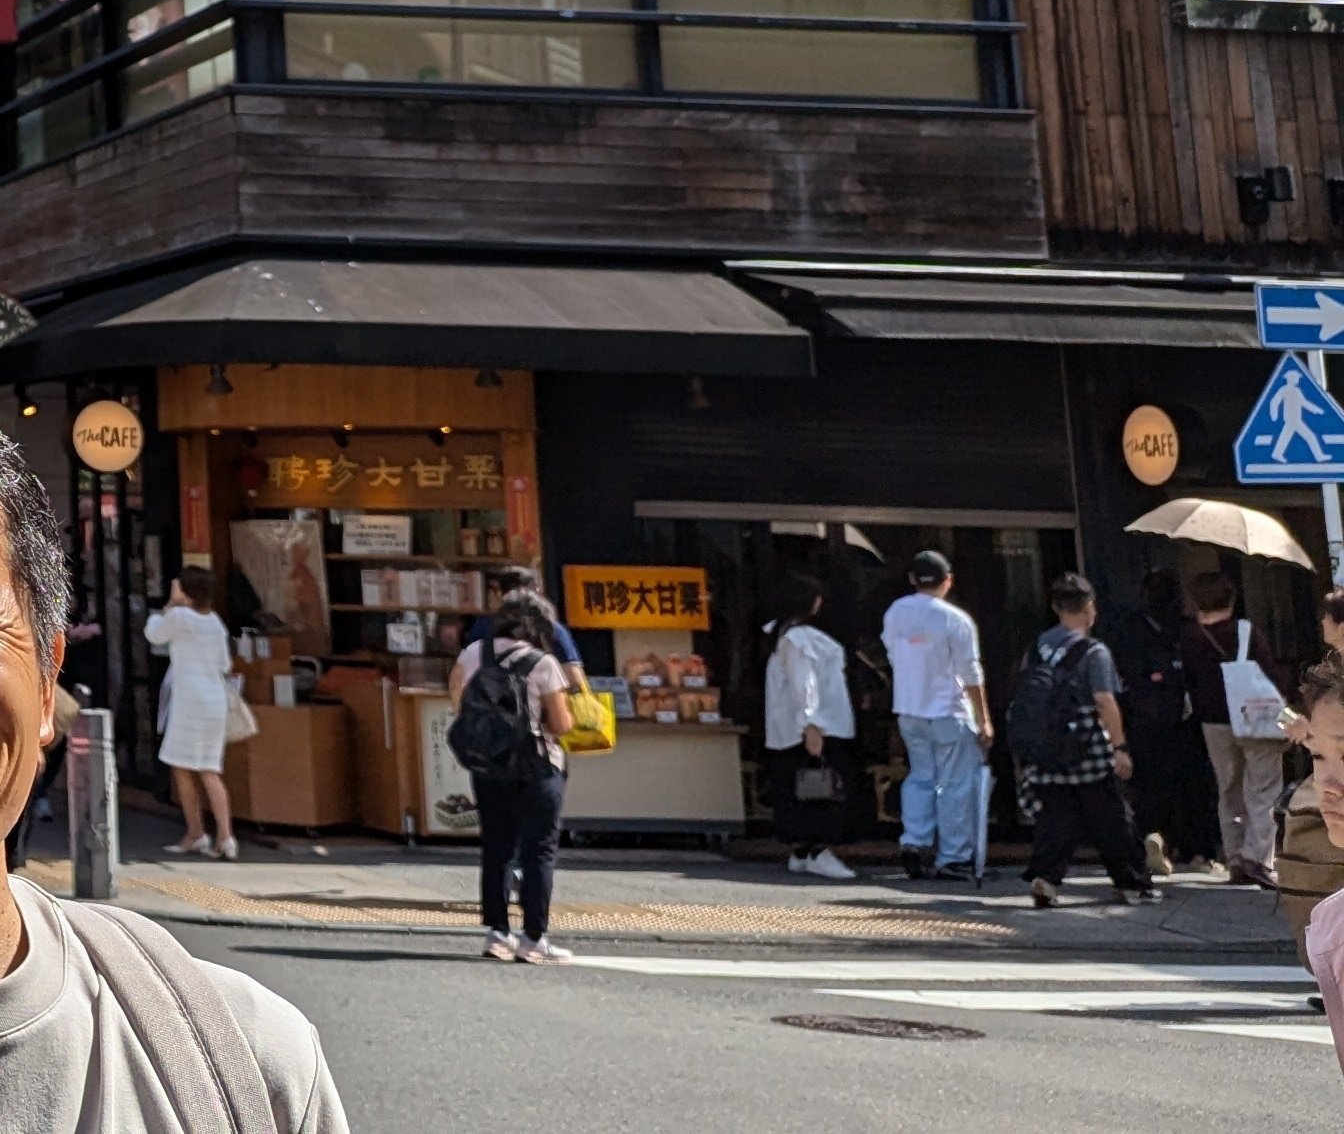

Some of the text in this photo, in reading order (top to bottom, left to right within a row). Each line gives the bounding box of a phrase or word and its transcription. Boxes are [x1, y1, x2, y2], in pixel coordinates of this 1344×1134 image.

[582, 580, 704, 616] 聘珍大甘栗
